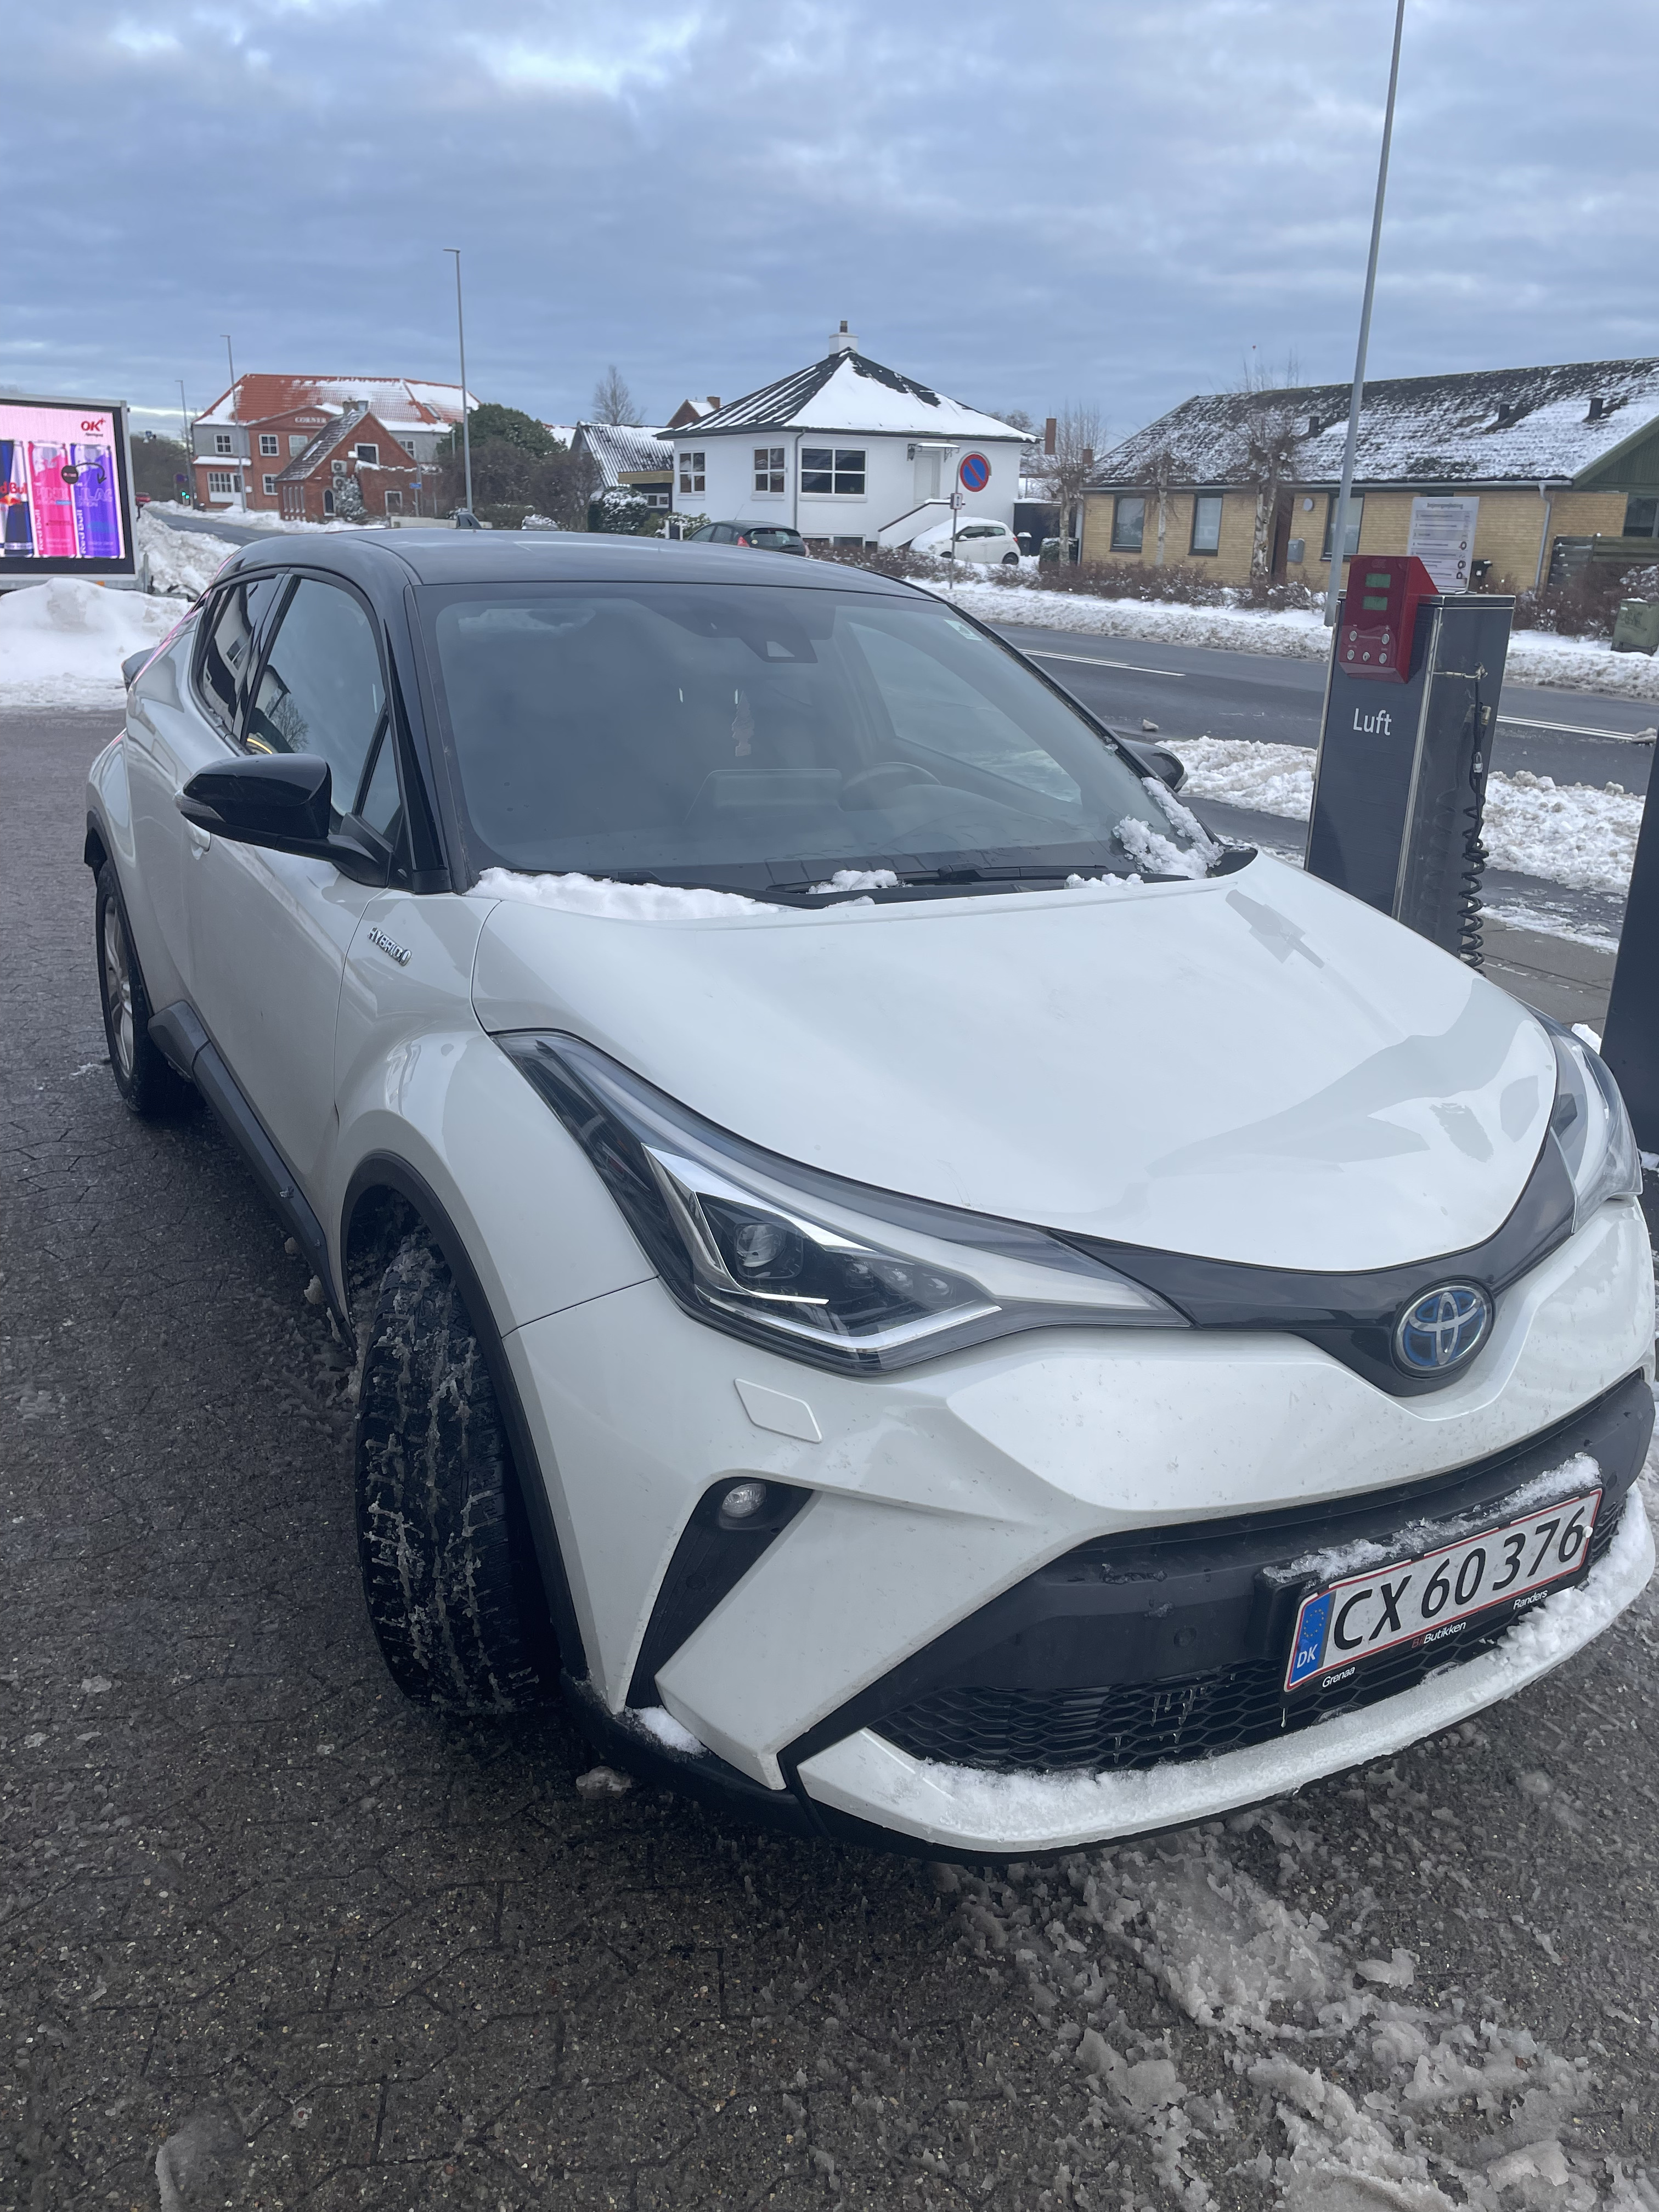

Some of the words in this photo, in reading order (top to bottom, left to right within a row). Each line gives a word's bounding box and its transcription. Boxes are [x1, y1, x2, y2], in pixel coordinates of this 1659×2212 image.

[1353, 708, 1392, 736] Luft
[1333, 1575, 1412, 1650] CX
[1421, 1547, 1486, 1619] 60
[1492, 1505, 1585, 1591] 376
[1513, 1589, 1548, 1610] Randers
[1296, 1644, 1318, 1669] DK
[1322, 1666, 1356, 1688] Grenaa
